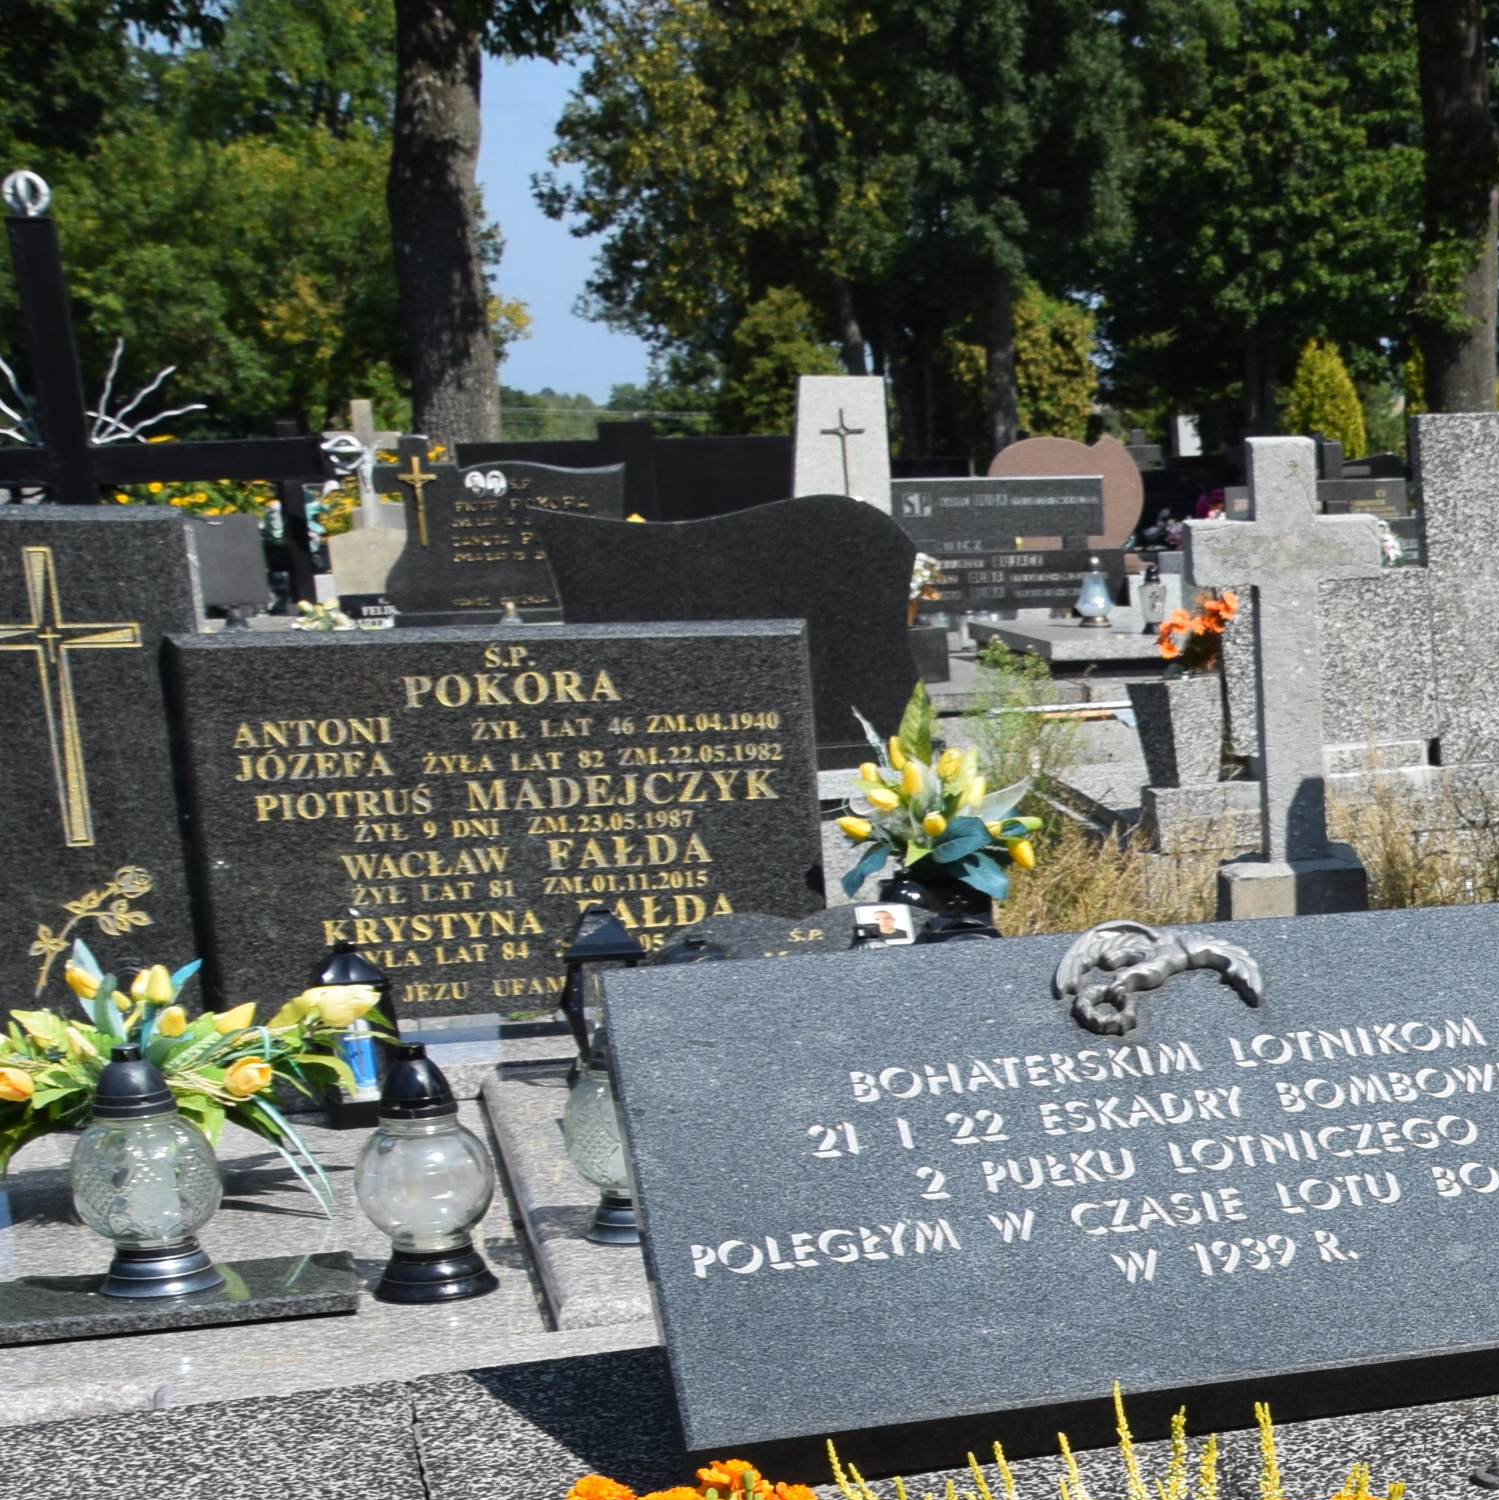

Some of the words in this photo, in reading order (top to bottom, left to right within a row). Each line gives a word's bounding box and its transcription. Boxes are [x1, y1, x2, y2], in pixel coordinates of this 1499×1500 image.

[402, 669, 622, 708] POKORA
[233, 717, 392, 748] ANTONI
[472, 718, 527, 741] ŻYŁ
[541, 717, 593, 738] LAT
[608, 716, 636, 735] 46
[646, 711, 779, 733] ZM.04.1940
[235, 749, 395, 782] JÓZEFA
[422, 751, 494, 774] ŻYŁA
[510, 751, 563, 771] LAT
[577, 750, 605, 769] 82
[618, 743, 784, 766] ZM.22.05.1982
[254, 783, 432, 822] PIOTRUŚ
[466, 768, 780, 812] MADEJCZYK
[354, 820, 409, 843] ŻYŁ
[422, 820, 438, 840] 9
[452, 818, 501, 838] DNI
[528, 809, 695, 834] ZM.23.05.1987
[341, 846, 510, 881] WACŁAW
[546, 832, 713, 871] FAŁDA
[353, 883, 407, 906] ŻYŁ
[421, 881, 475, 902] LAT
[489, 879, 516, 898] 81
[543, 870, 710, 895] ZM.01.11.2015
[322, 910, 544, 946] KRYSTYNA
[362, 949, 421, 968] YŁA
[435, 943, 488, 964] LAT
[502, 942, 530, 961] 84
[403, 981, 470, 1002] JEZU
[492, 976, 567, 997] UFAM
[849, 1041, 1203, 1103] BOHATERSKIM
[1230, 1017, 1488, 1068] LOTNIKOM
[807, 1121, 860, 1159] 21
[945, 1109, 1010, 1145] 22
[1039, 1085, 1242, 1136] ESKADRY
[915, 1166, 951, 1200] 2
[982, 1147, 1136, 1194] PUŁKU
[1169, 1114, 1478, 1174] LOTNICZEGO
[690, 1217, 962, 1279] POLEGŁYM
[988, 1208, 1036, 1244] W
[1071, 1187, 1249, 1236] CZASIE
[1275, 1170, 1401, 1214] LOTU
[1110, 1248, 1160, 1284] W
[1187, 1234, 1297, 1277] 1939
[1314, 1230, 1359, 1263] R.
